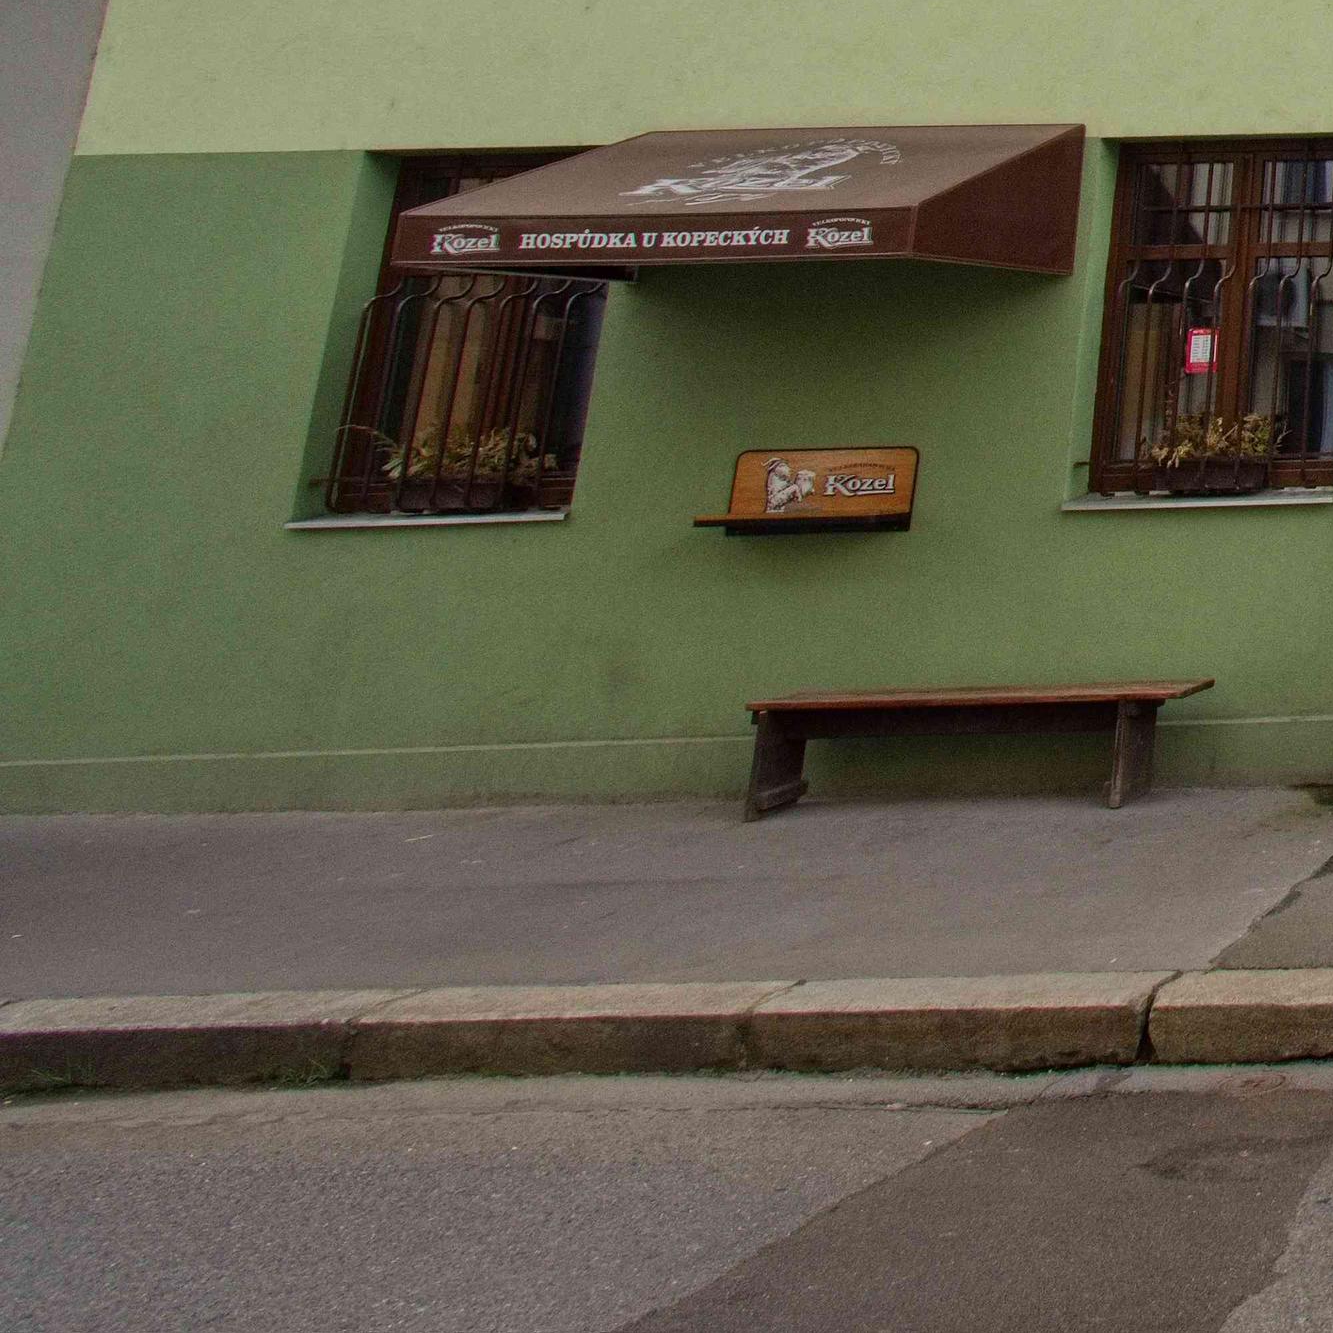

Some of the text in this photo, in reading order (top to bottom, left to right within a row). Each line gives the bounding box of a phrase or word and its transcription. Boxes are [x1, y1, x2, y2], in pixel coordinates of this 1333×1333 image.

[430, 233, 500, 256] Kozel
[518, 226, 790, 250] HOSPŮDKA U KOPECKÝCH
[805, 226, 874, 250] Kozel
[823, 473, 896, 497] Kozel
